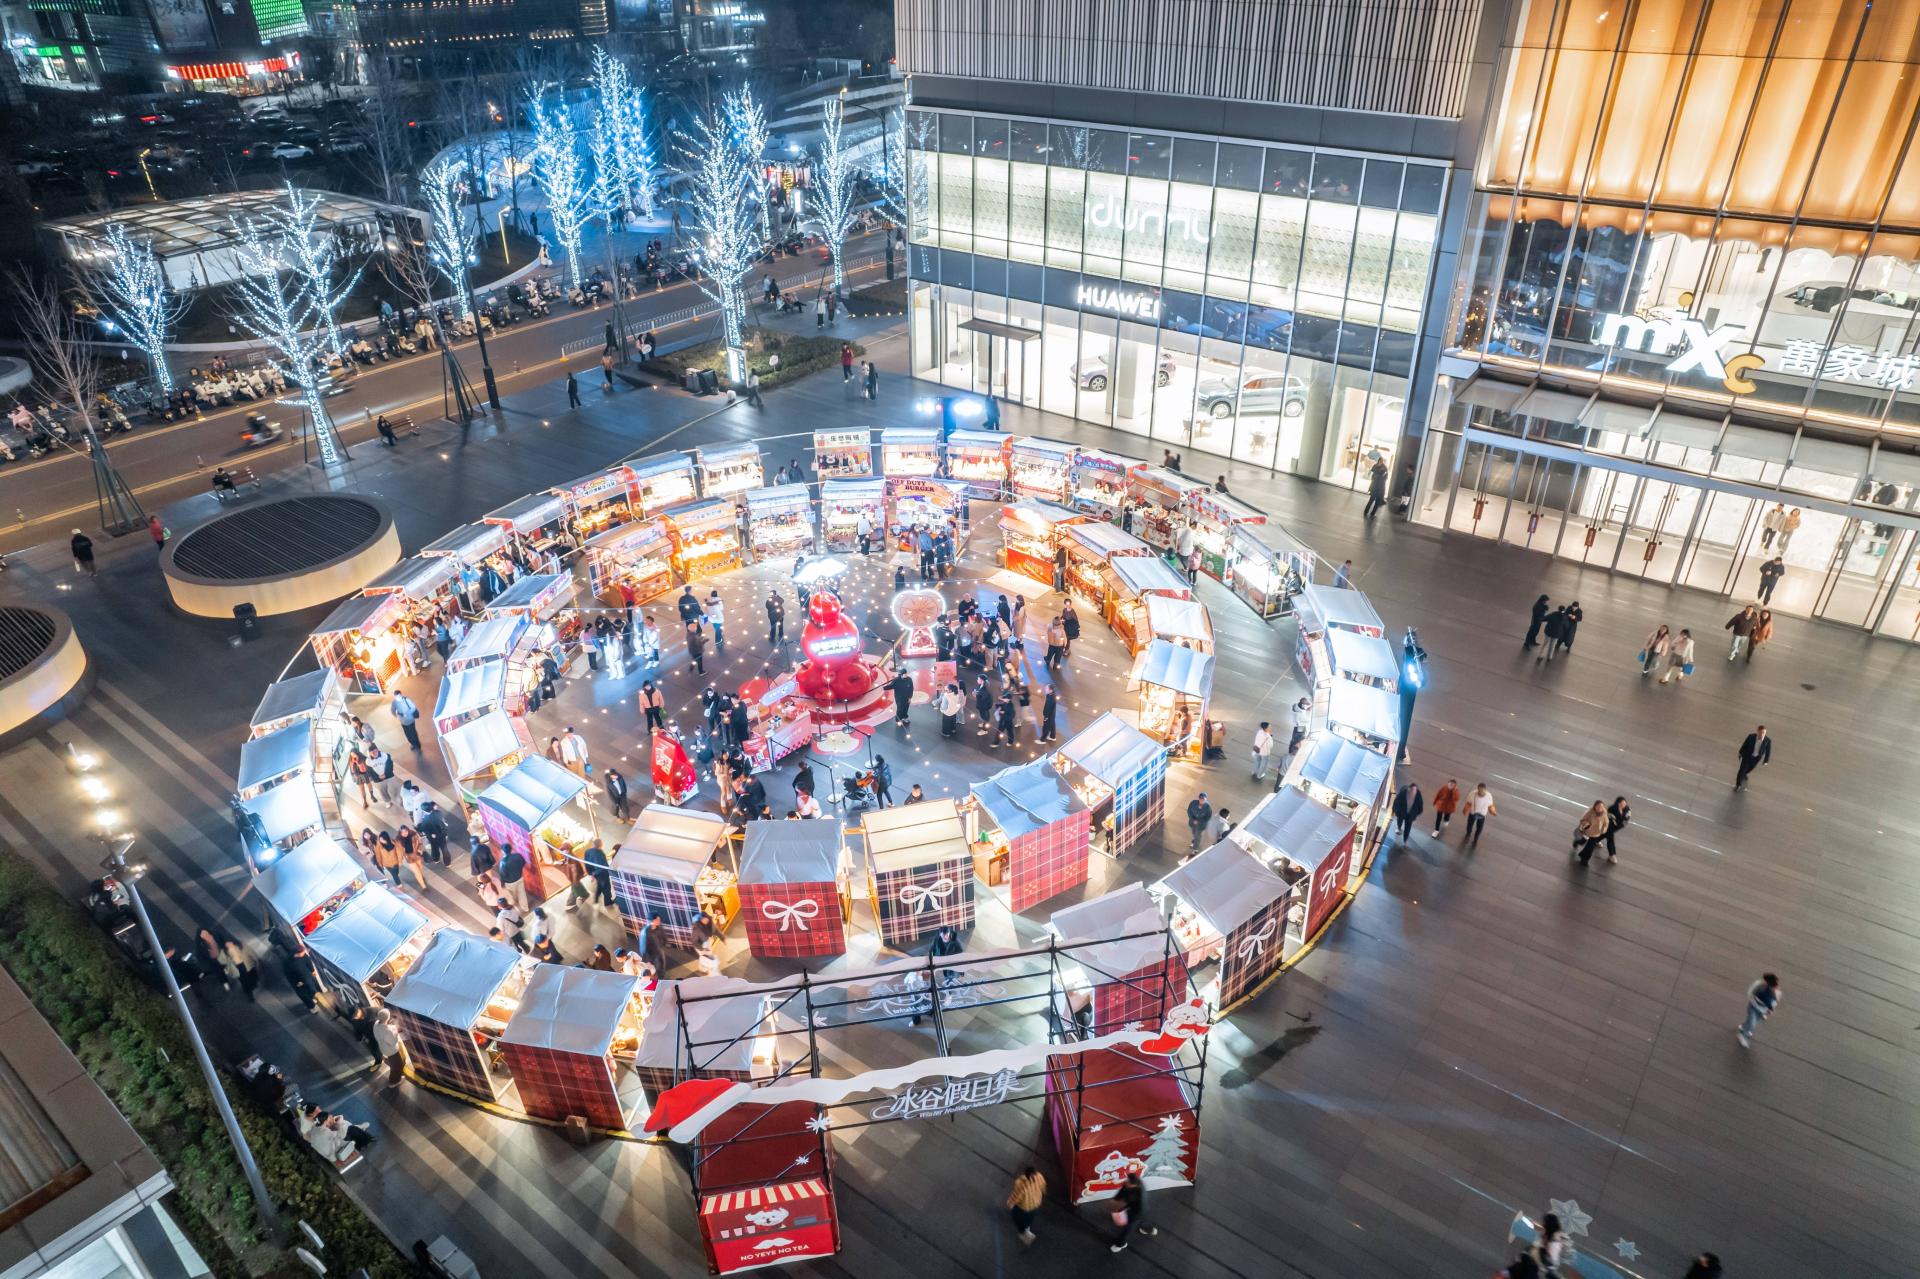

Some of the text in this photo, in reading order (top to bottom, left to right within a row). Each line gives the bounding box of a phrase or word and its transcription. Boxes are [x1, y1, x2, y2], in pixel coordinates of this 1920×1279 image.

[1077, 285, 1160, 319] HUAWEI
[1777, 338, 1920, 390] 萬象城
[886, 1068, 1022, 1115] 冰谷假日集
[754, 1250, 777, 1258] YEYE
